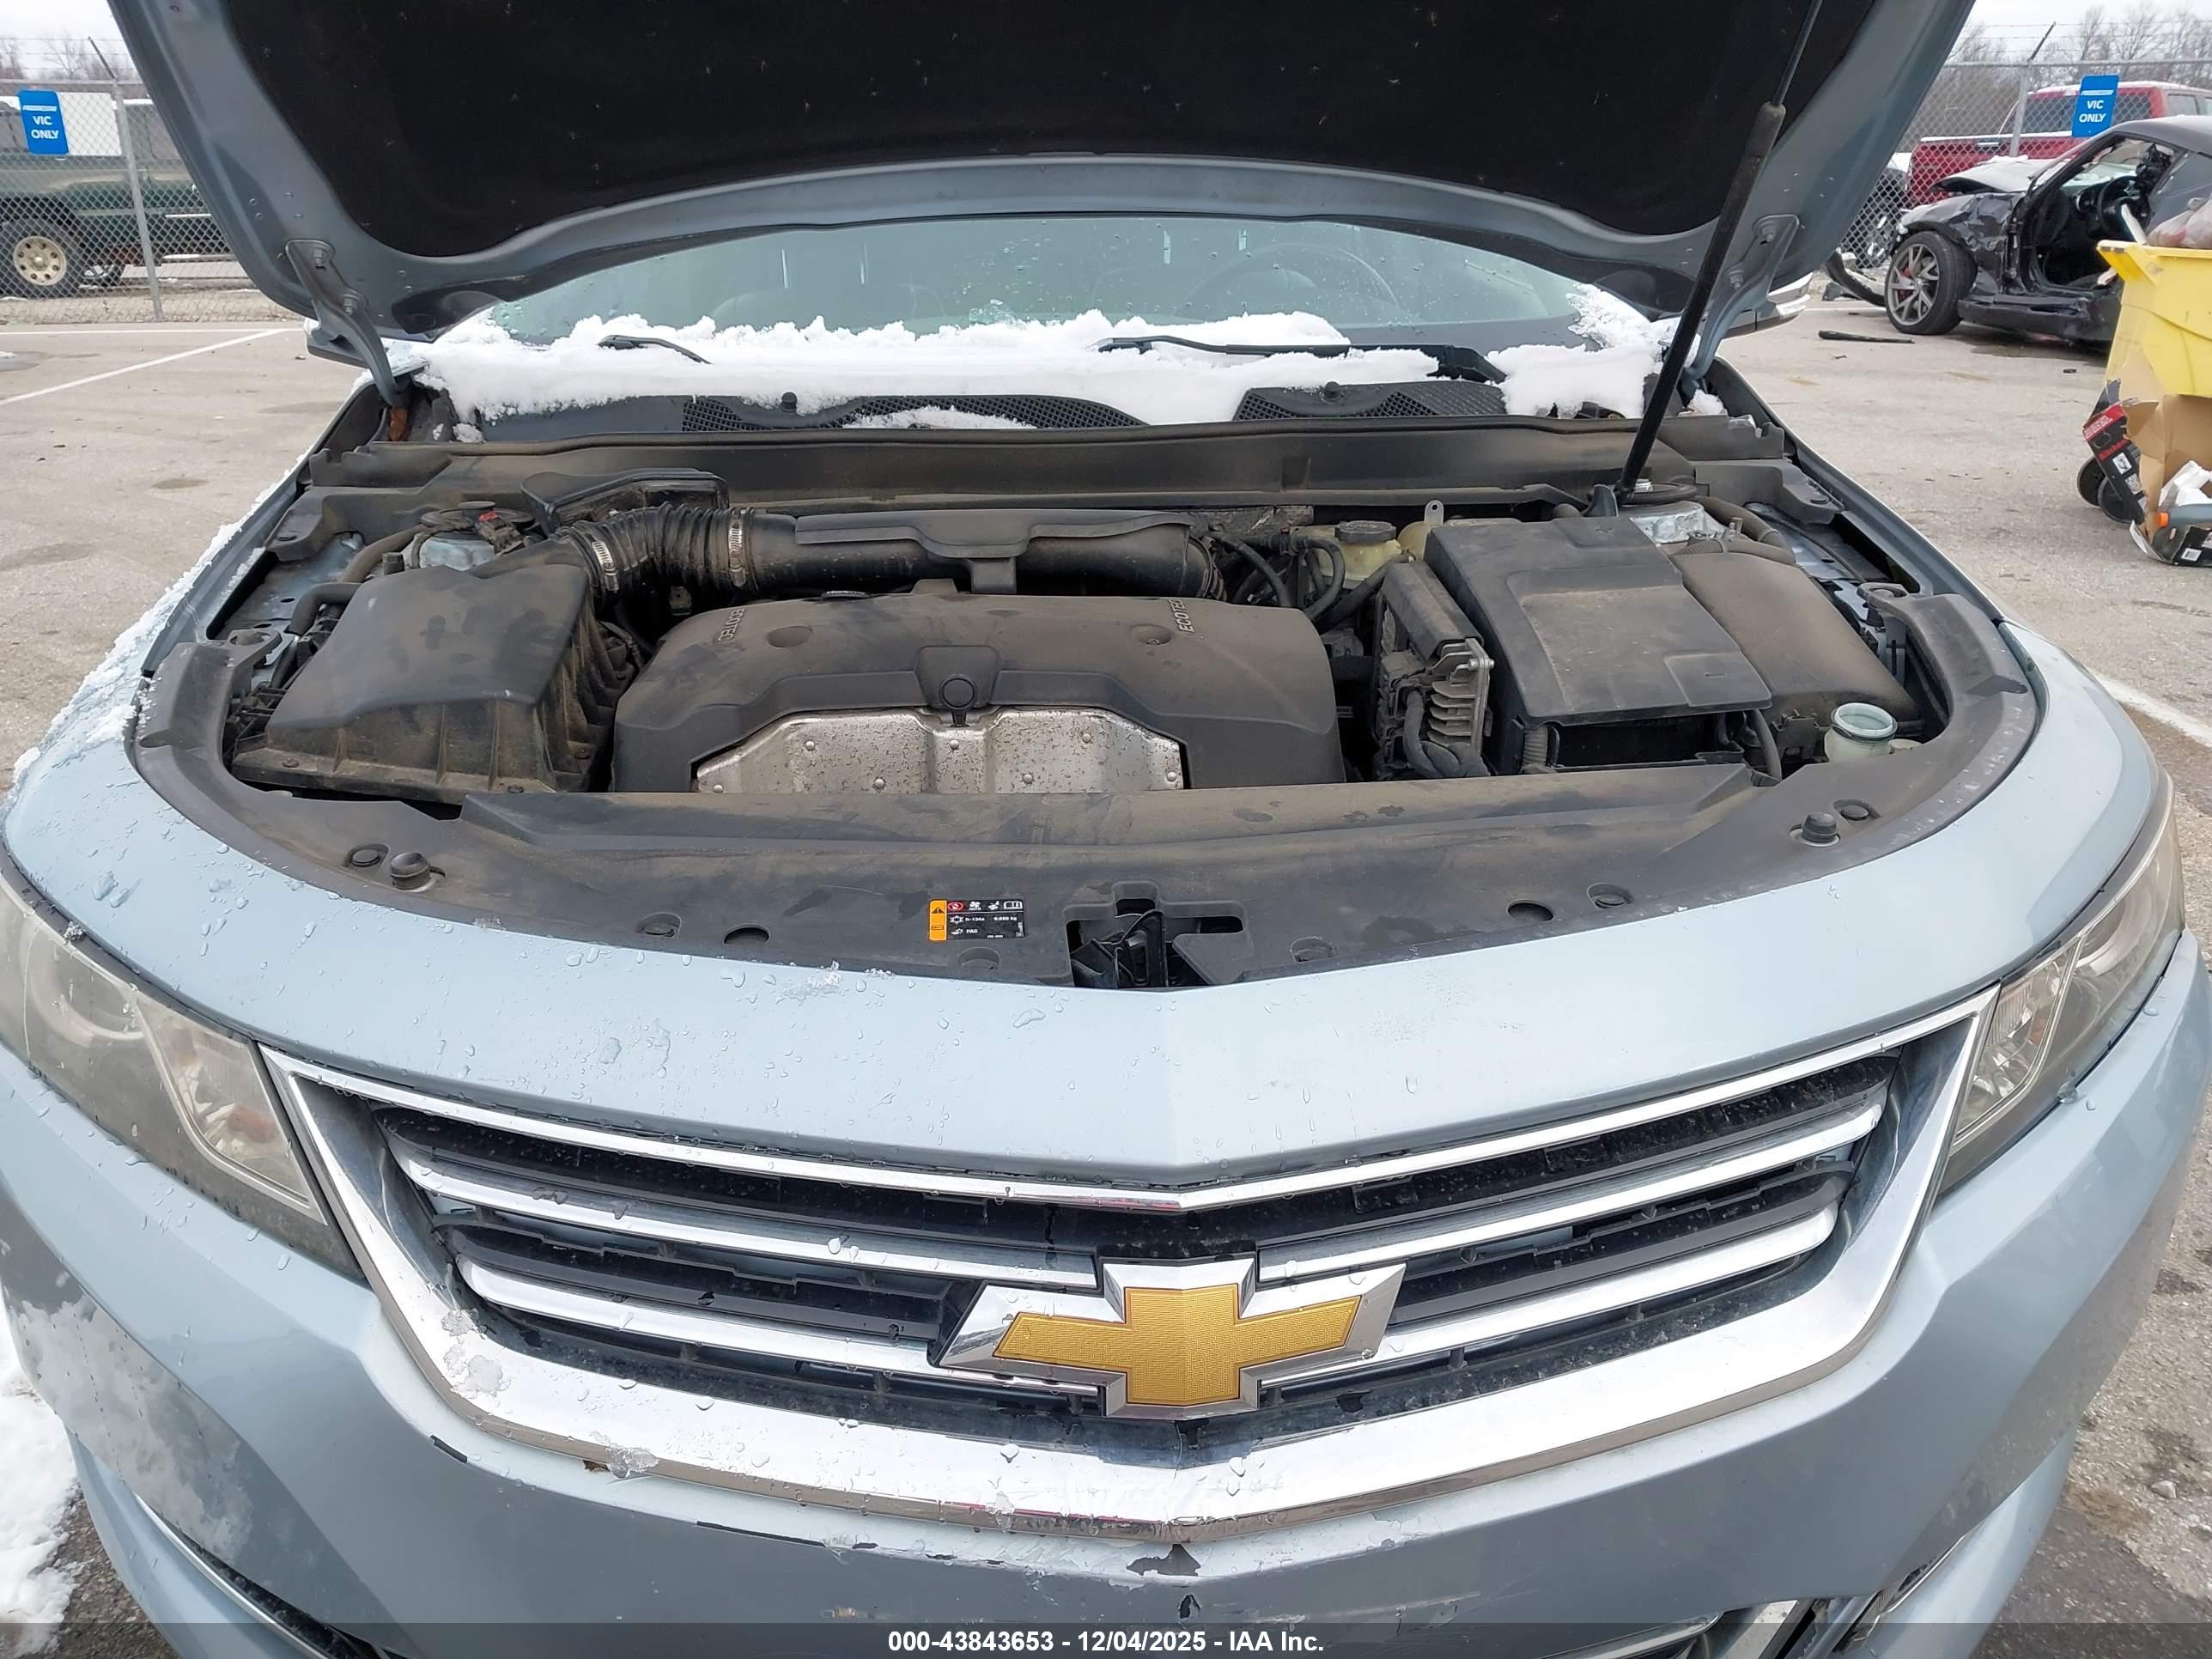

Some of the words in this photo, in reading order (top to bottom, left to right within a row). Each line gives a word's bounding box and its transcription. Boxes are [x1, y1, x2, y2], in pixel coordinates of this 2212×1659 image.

[2087, 100, 2105, 110] VIC
[33, 115, 52, 125] VIC
[2079, 112, 2106, 123] ONLY
[31, 129, 59, 139] ONLY
[1168, 599, 1194, 633] ECOTEC
[718, 608, 745, 641] ECOTEC
